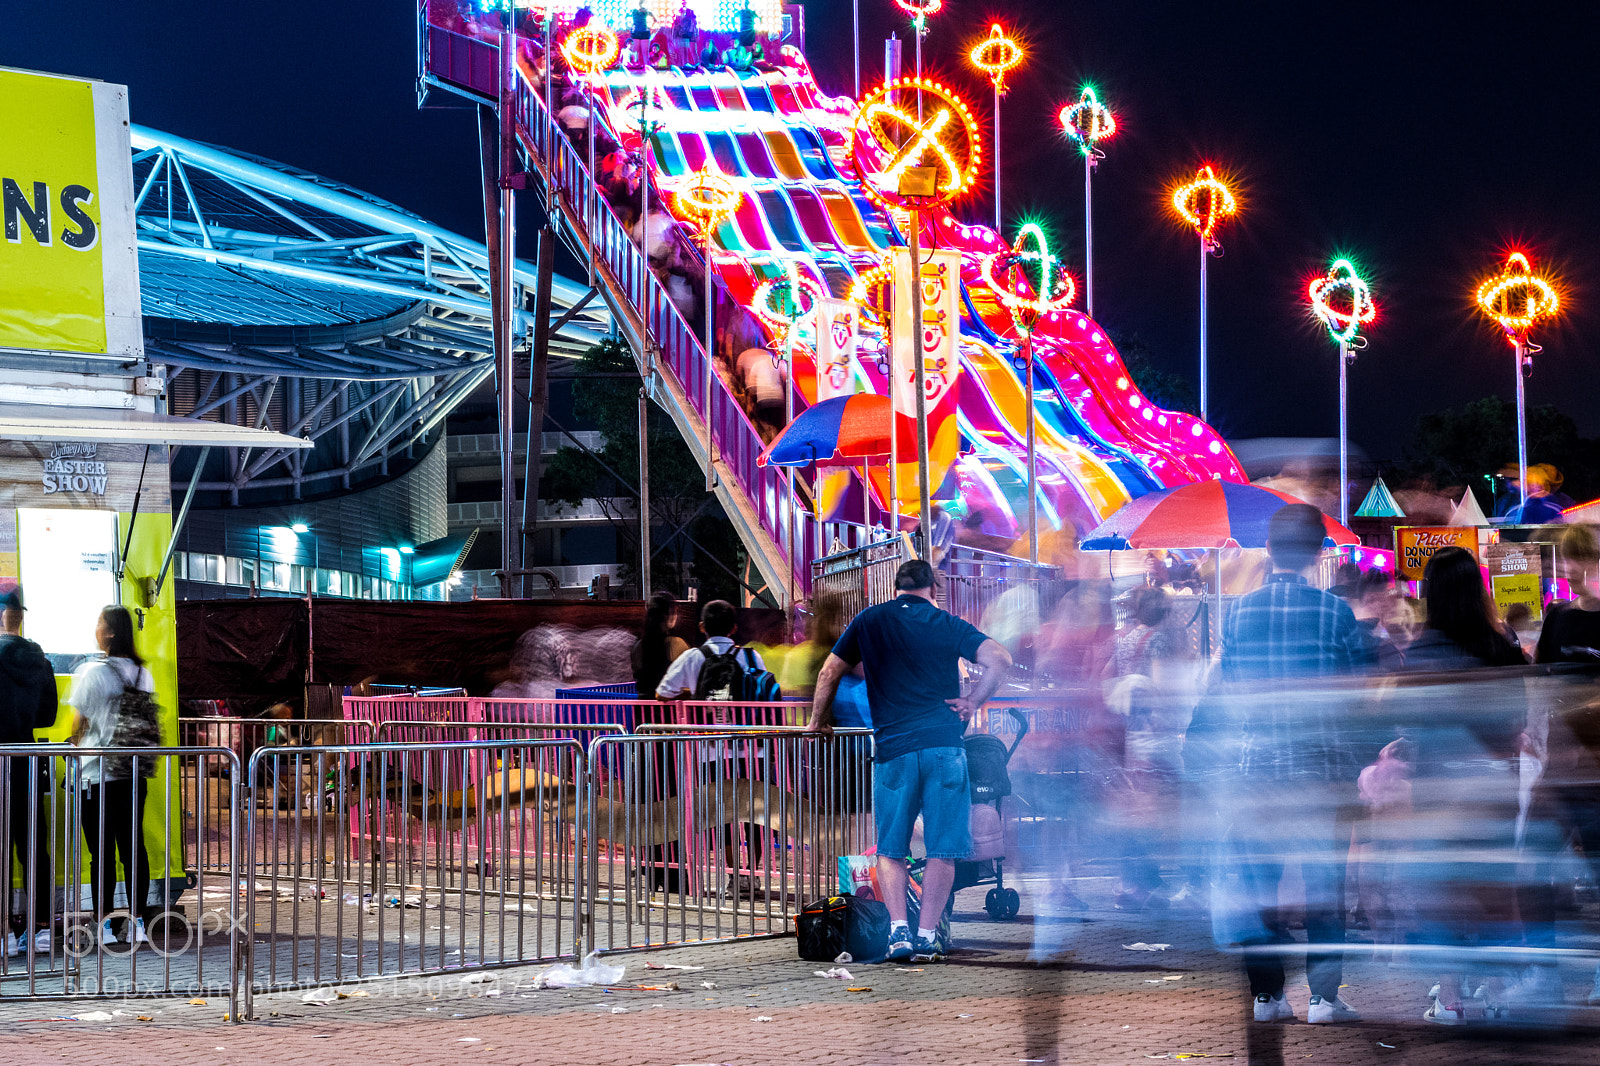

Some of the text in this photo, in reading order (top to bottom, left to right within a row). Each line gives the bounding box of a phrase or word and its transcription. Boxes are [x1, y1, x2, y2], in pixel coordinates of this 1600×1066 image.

[2, 177, 99, 252] NS
[43, 460, 107, 475] EASTER
[42, 474, 107, 495] SHOW
[1405, 546, 1438, 557] DO NOT
[1407, 557, 1421, 568] ON
[1501, 564, 1528, 572] SHOW
[1501, 587, 1517, 595] Super
